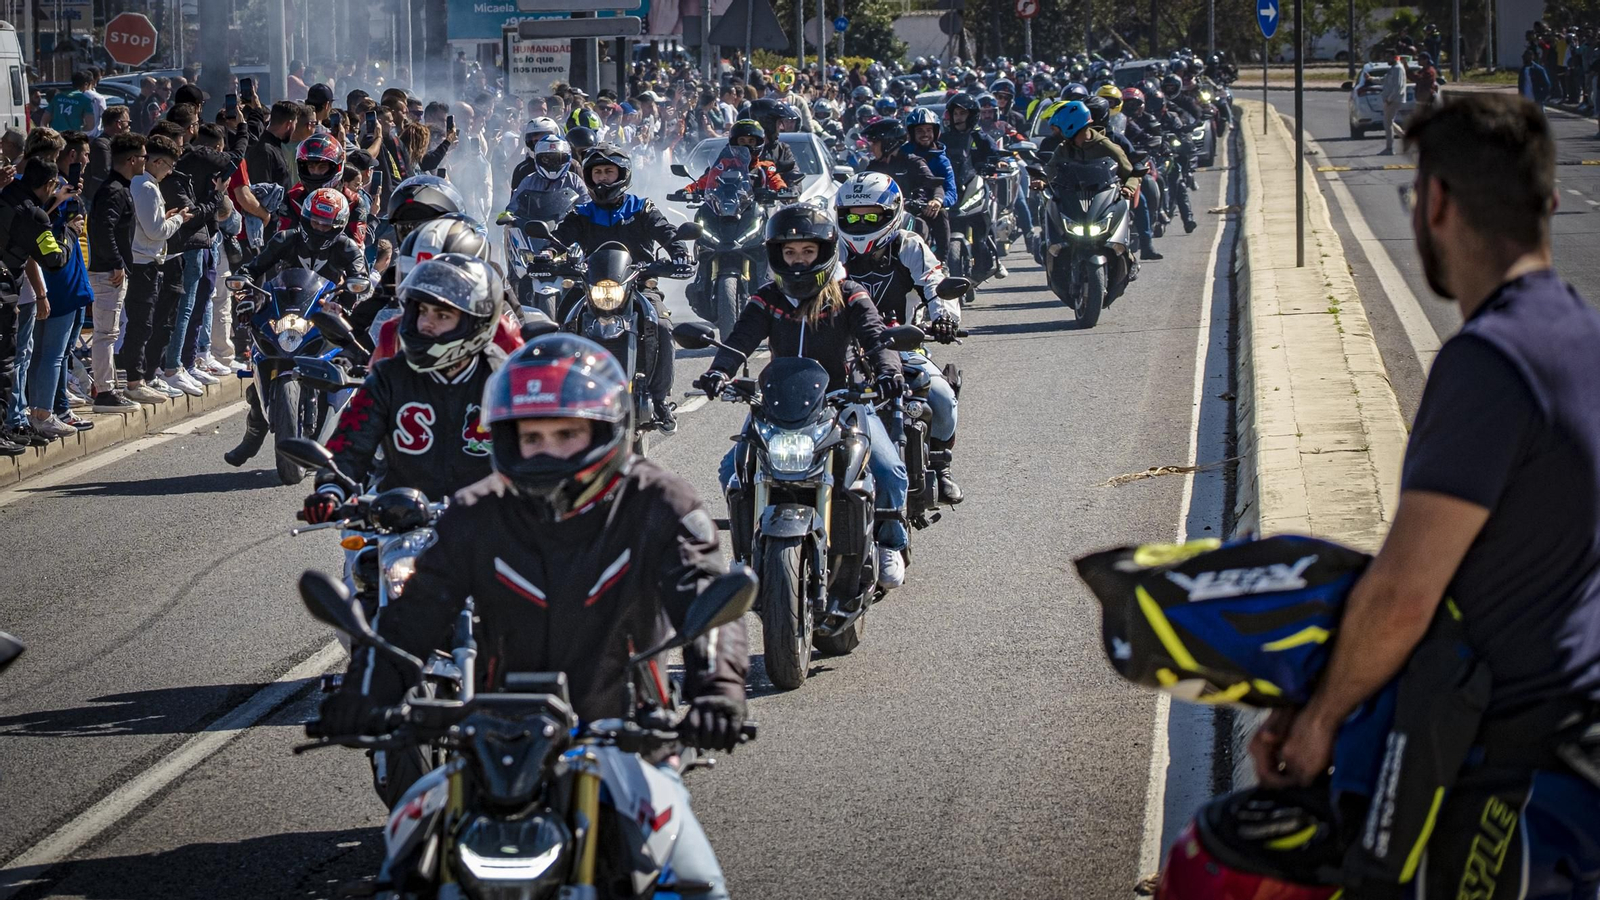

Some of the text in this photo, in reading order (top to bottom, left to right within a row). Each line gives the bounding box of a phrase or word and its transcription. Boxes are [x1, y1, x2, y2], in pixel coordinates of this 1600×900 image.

[474, 3, 515, 13] Micaela
[110, 31, 151, 47] STOP
[512, 45, 572, 54] HUMANIDAD
[525, 55, 534, 63] lo
[59, 103, 73, 115] 14
[393, 402, 435, 455] S
